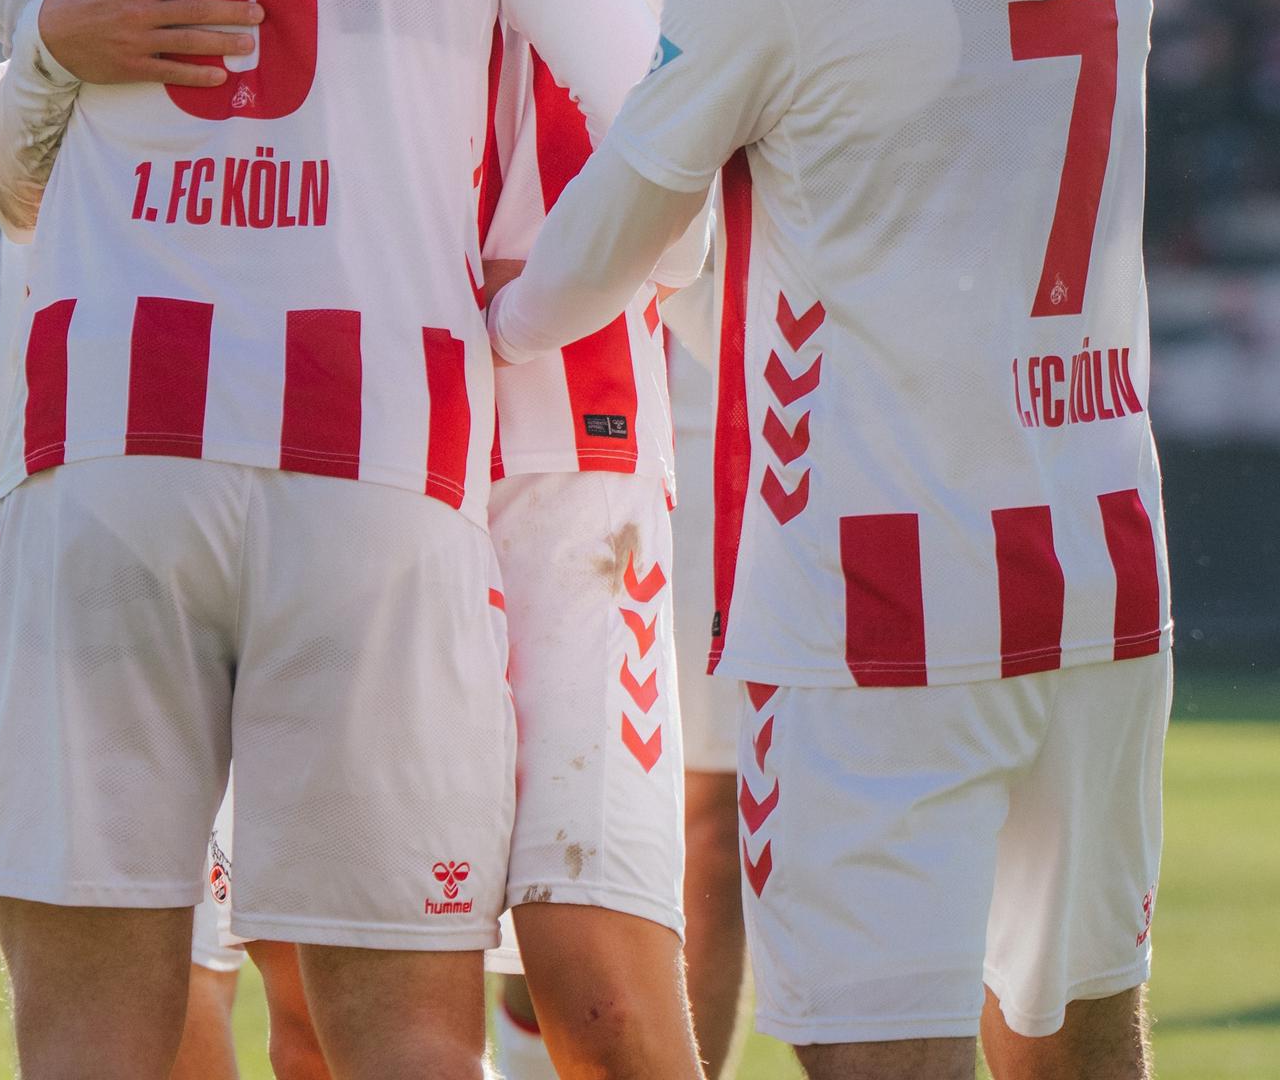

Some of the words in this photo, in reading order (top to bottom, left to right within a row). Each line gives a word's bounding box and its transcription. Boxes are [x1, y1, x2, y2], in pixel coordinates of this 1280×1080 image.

[131, 162, 158, 222] 1.
[166, 158, 215, 224] FC
[222, 146, 329, 228] KÖLN
[1028, 355, 1065, 428] FC
[425, 898, 473, 914] hummel
